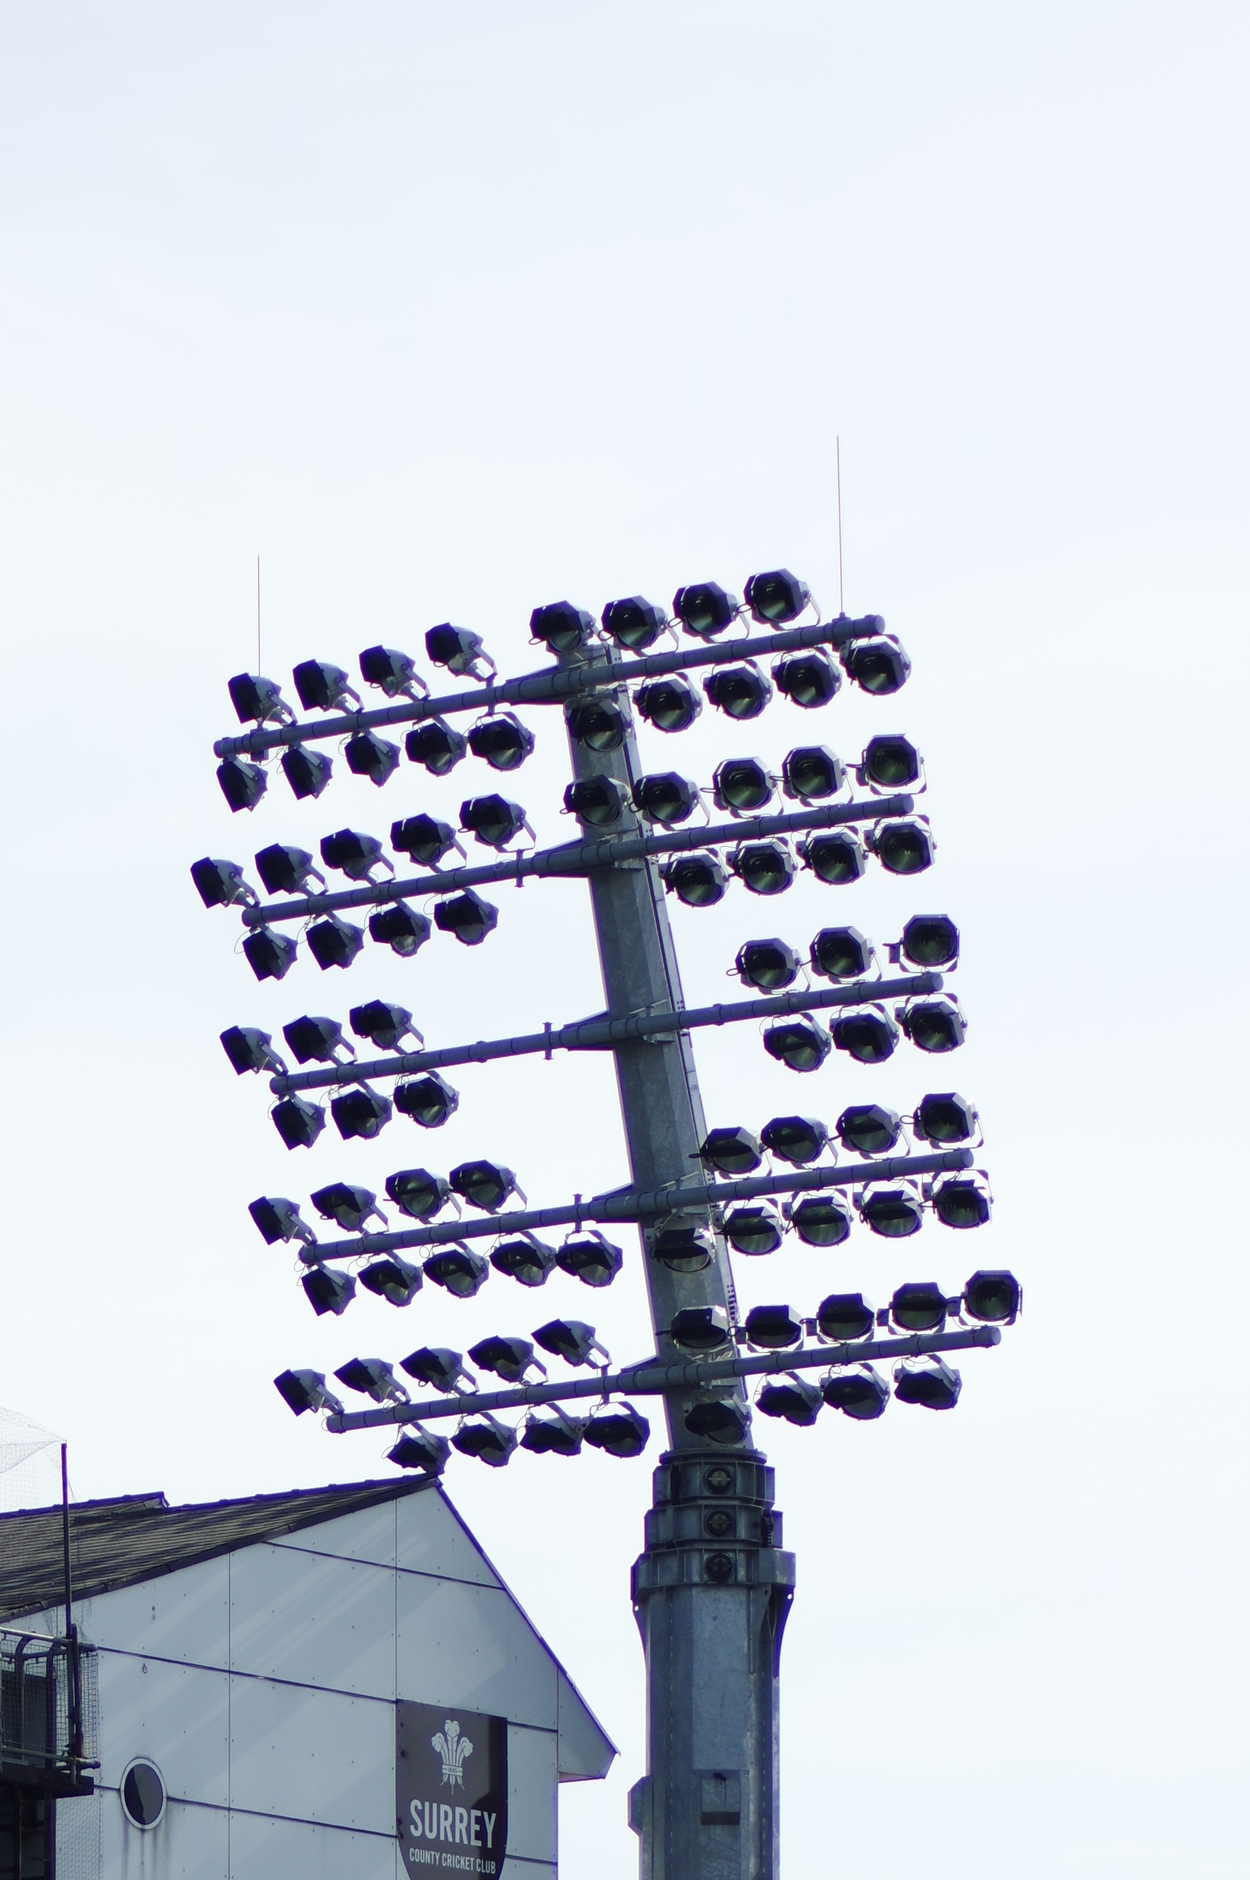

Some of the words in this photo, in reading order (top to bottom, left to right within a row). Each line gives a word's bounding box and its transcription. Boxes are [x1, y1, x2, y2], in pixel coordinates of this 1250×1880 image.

[409, 1799, 497, 1849] SURREY
[409, 1848, 440, 1866] COUNTY
[441, 1852, 474, 1871] CRICKET
[476, 1858, 496, 1876] CLUB
